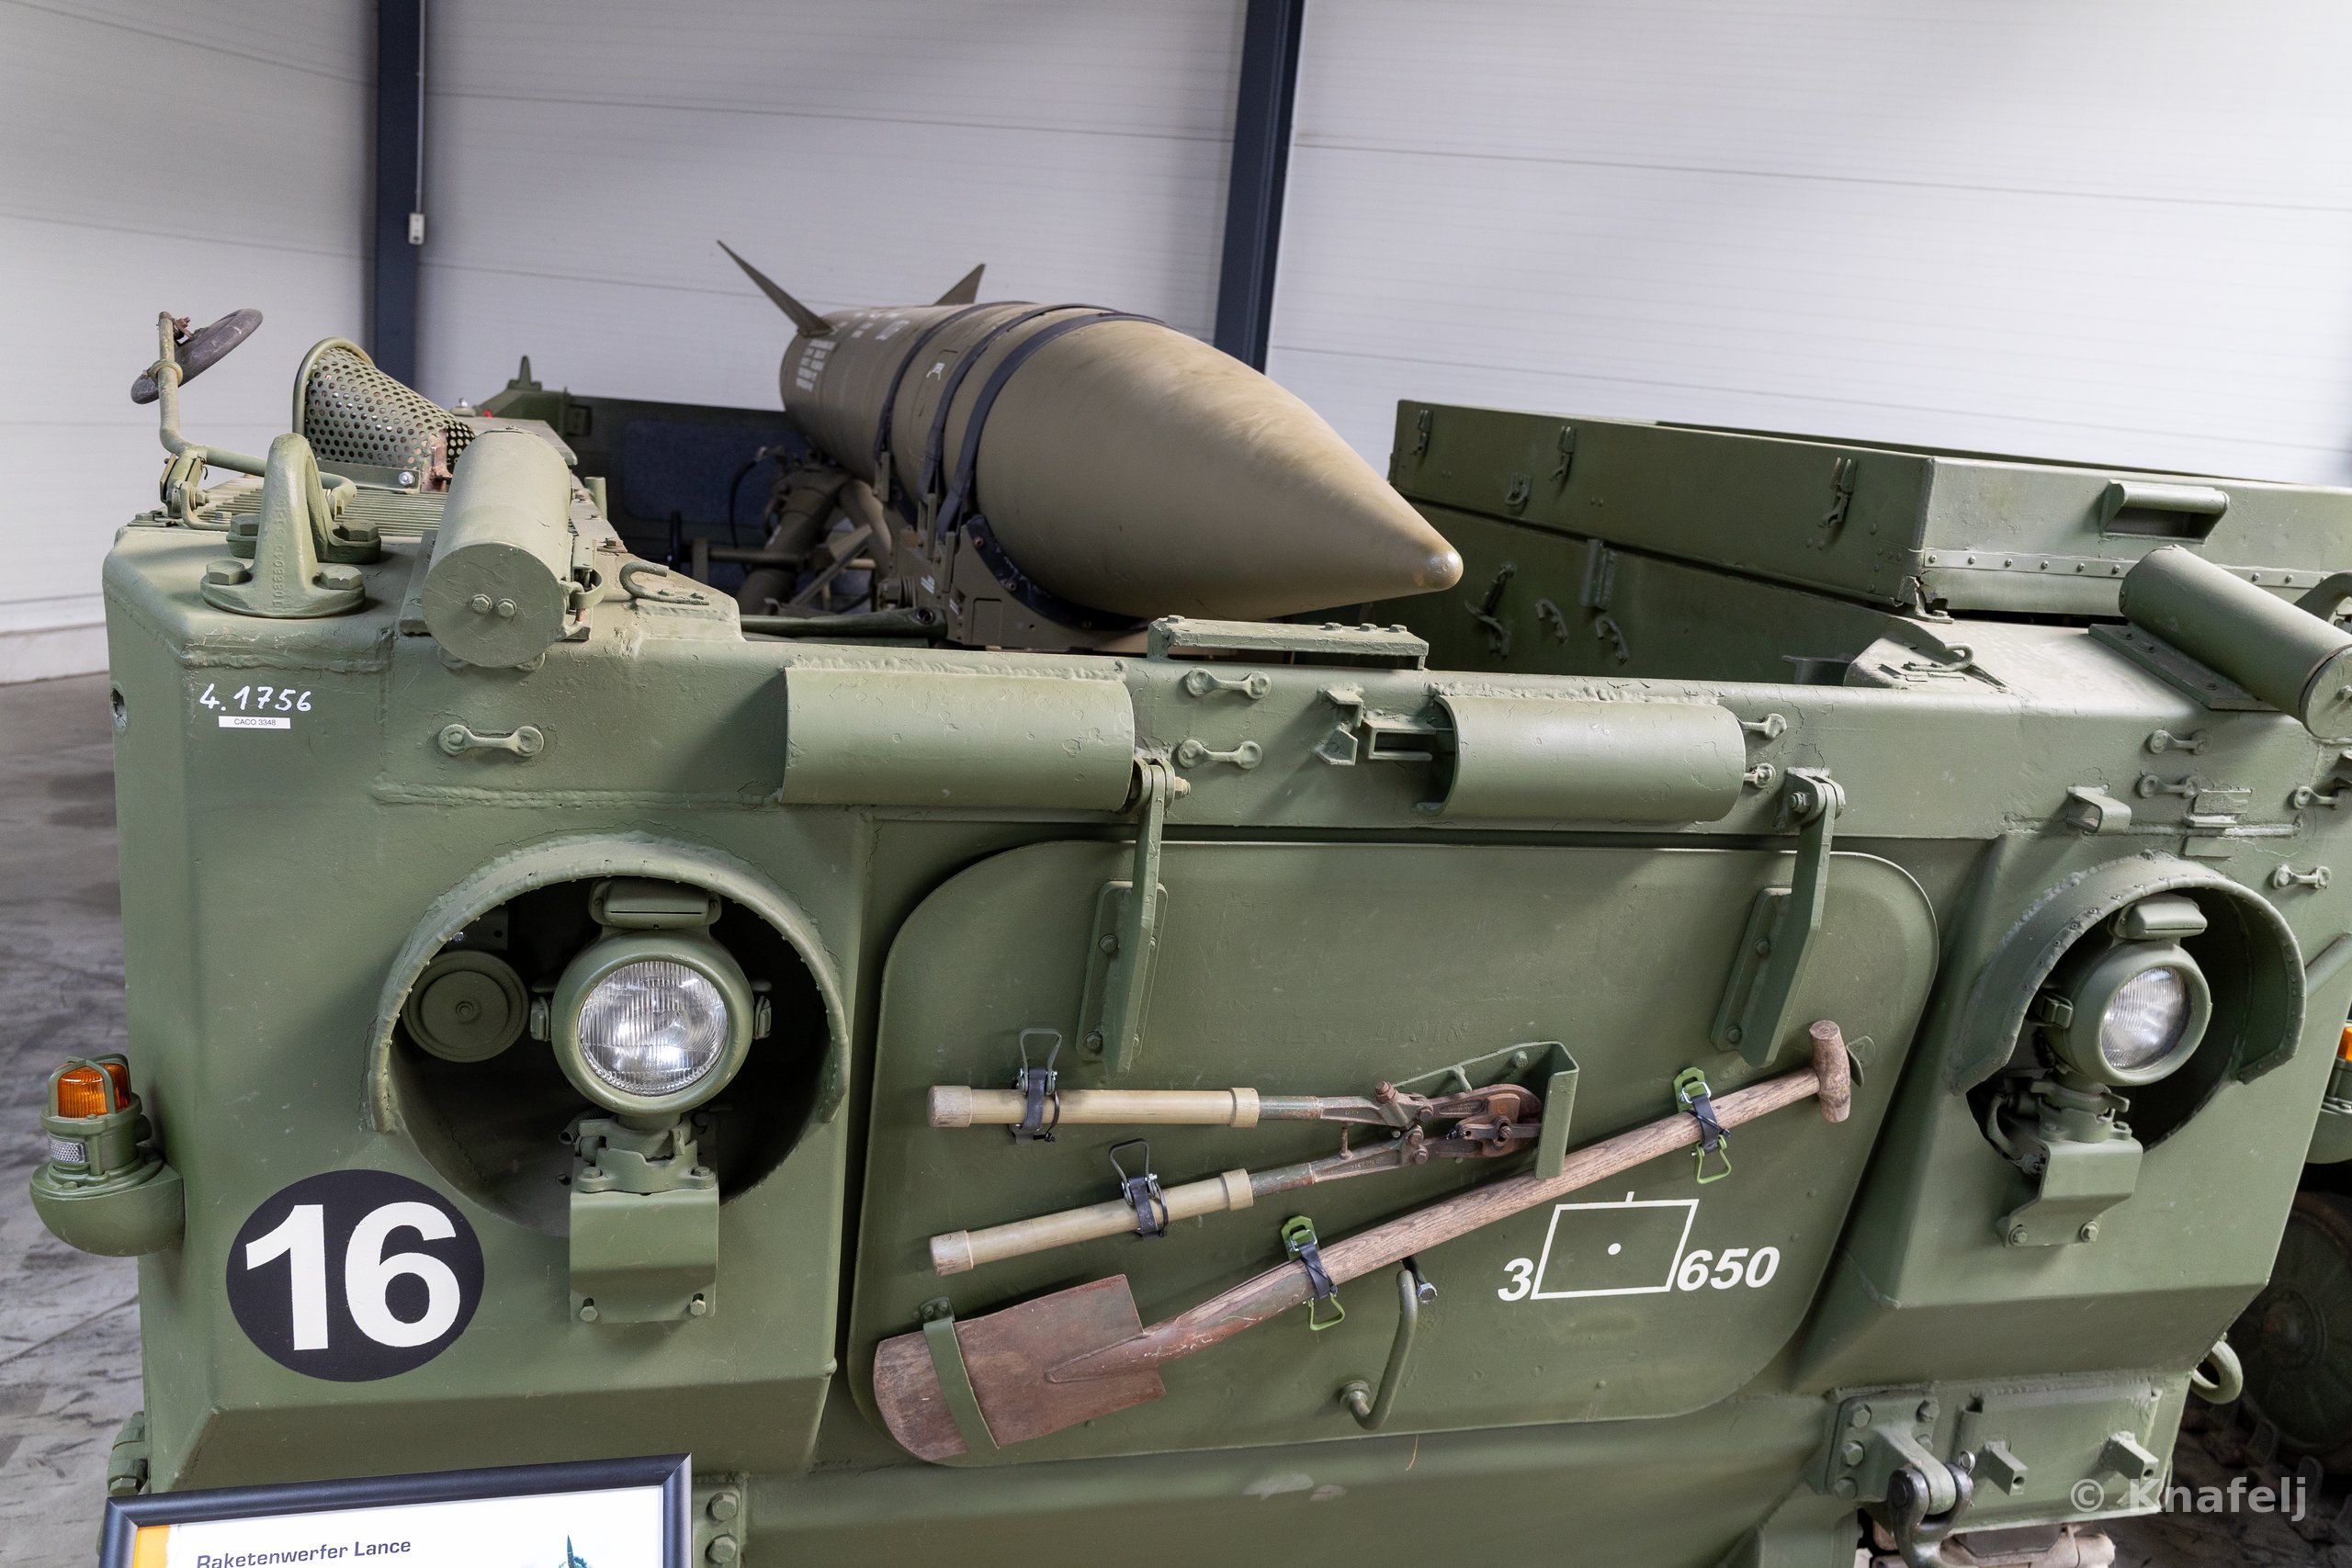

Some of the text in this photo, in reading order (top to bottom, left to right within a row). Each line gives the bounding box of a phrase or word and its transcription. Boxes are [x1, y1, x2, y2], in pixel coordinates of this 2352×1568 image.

[199, 683, 311, 712] 4.1756
[258, 718, 277, 727] 3348
[245, 1201, 460, 1350] 16
[1498, 1247, 1781, 1301] 3 650
[196, 1541, 412, 1568] Raketenwerfer Lance
